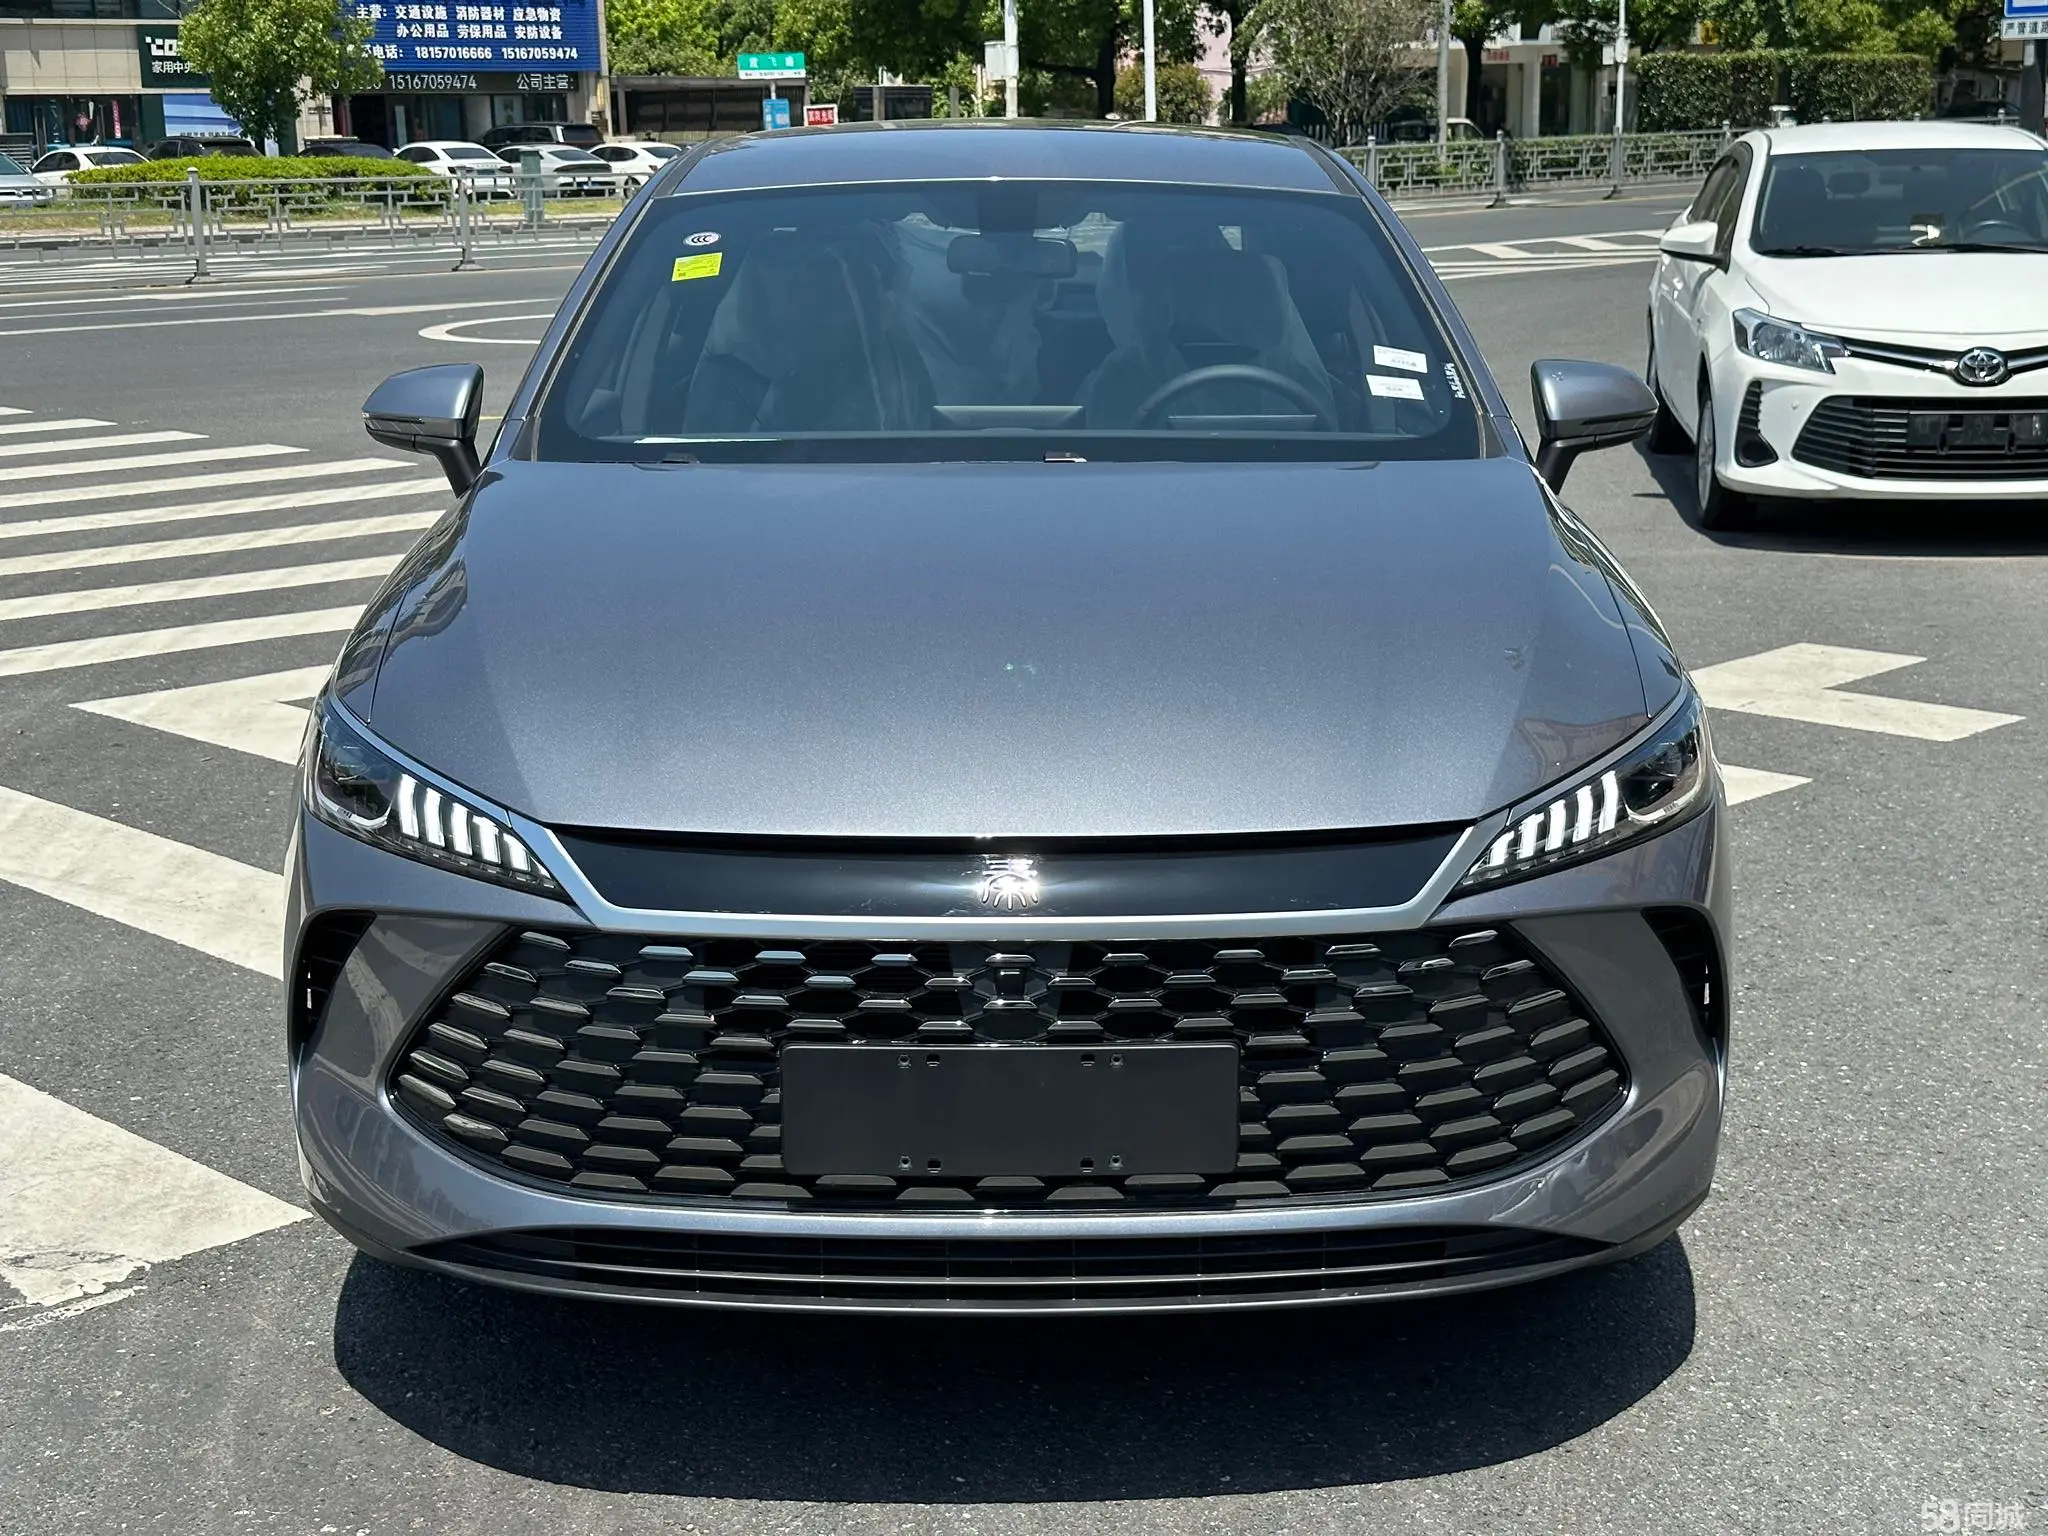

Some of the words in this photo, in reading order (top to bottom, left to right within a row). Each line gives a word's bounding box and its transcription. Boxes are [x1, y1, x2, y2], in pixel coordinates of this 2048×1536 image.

[395, 5, 448, 19] 交通设施
[456, 6, 505, 20] 消防器材
[513, 7, 561, 21] 应急物资
[397, 23, 449, 38] 办公用品
[457, 24, 507, 39] 劳保用品
[514, 25, 563, 39] 安防设备
[415, 46, 493, 59] 18157016666
[501, 47, 578, 60] 15167059474
[389, 74, 477, 89] 15167059474
